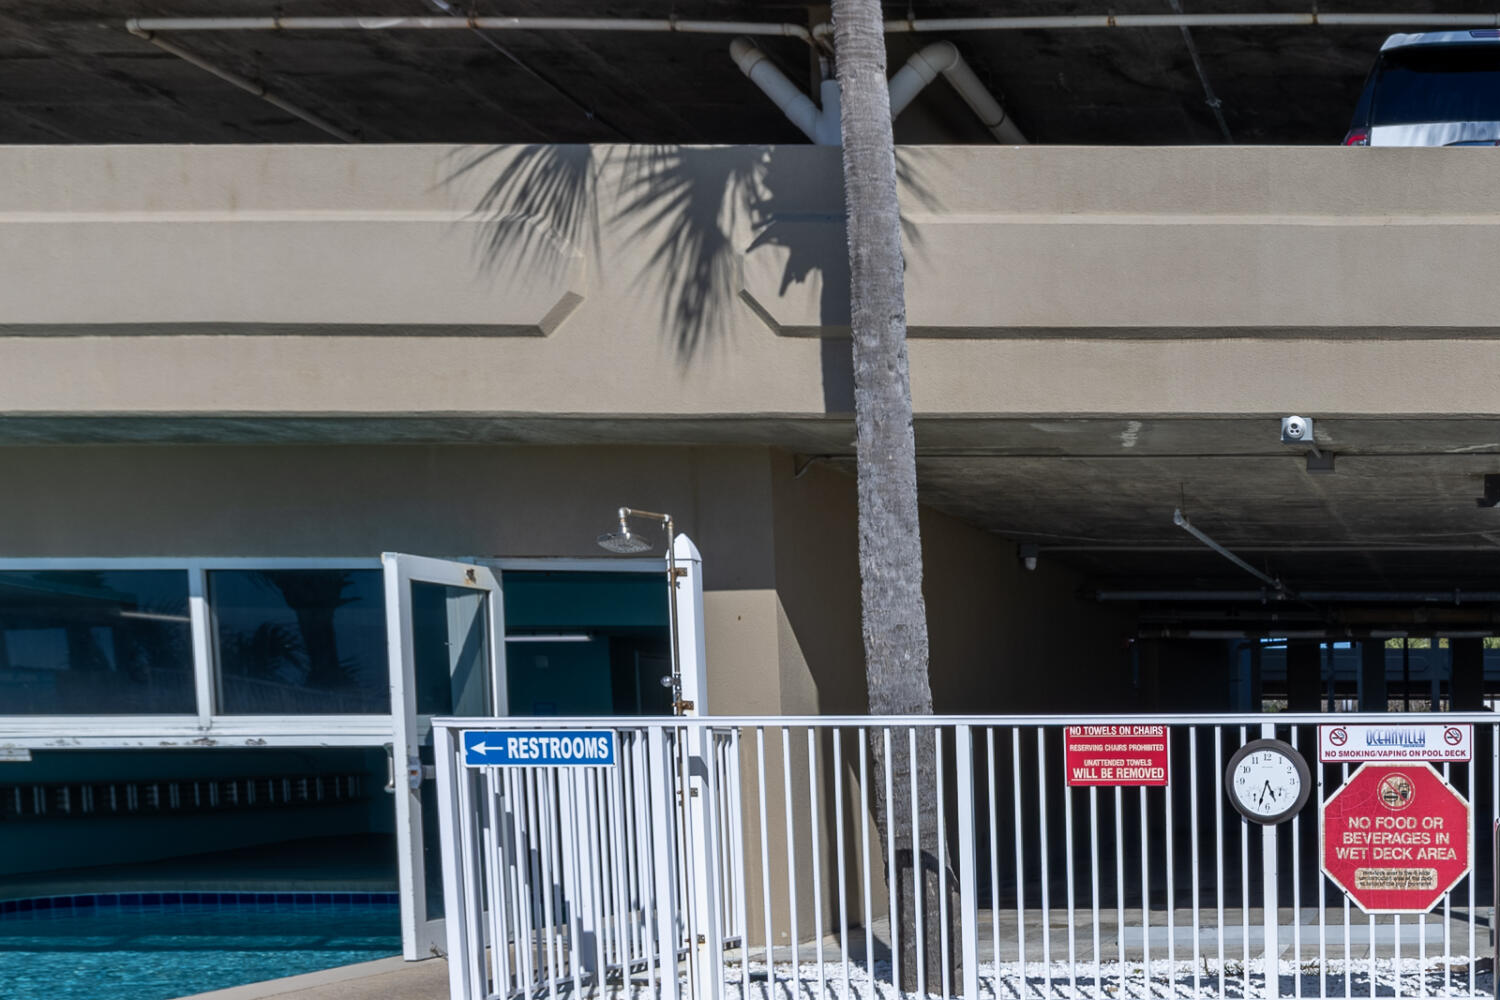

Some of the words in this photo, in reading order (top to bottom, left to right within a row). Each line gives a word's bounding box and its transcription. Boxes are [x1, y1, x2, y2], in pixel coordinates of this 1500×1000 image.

[1070, 726, 1081, 735] NO
[1084, 726, 1116, 735] TOWELS
[1119, 726, 1130, 735] ON
[1133, 726, 1163, 735] CHAIRS
[1366, 728, 1426, 746] OCEANVILLA
[508, 737, 608, 759] RESTROOMS
[1264, 753, 1272, 761] 12
[1073, 768, 1097, 778] WILL
[1101, 768, 1113, 778] BE
[1116, 768, 1164, 778] REMOVED
[1348, 817, 1371, 829] NO
[1376, 817, 1417, 829] FOOD
[1422, 817, 1444, 828] OR
[1343, 832, 1430, 844] BEVERAGES
[1436, 832, 1449, 844] IN
[1336, 848, 1368, 860] WET
[1373, 848, 1413, 860] DECK
[1417, 848, 1456, 859] AREA
